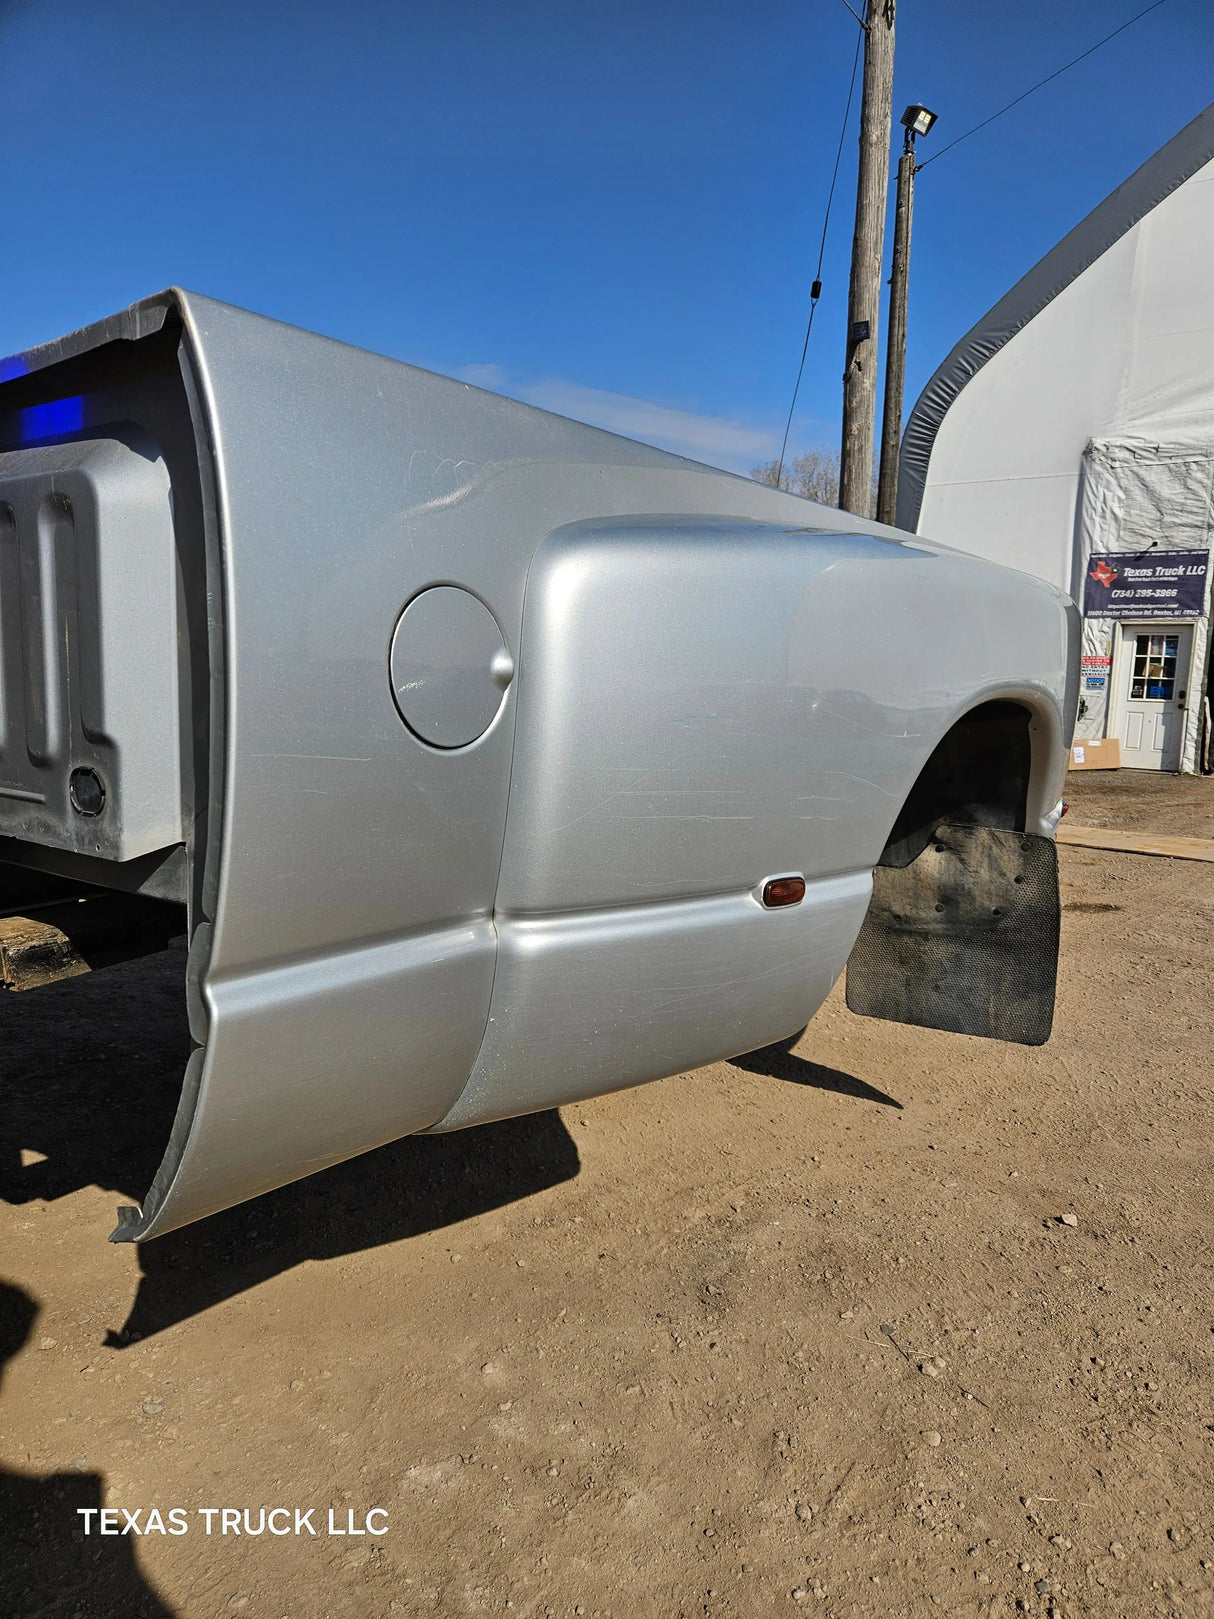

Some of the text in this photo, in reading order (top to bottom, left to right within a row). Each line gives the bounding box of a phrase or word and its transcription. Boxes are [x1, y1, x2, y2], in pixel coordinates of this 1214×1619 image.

[1123, 565, 1206, 577] Texas Truck LLC
[1111, 589, 1134, 598] (734)
